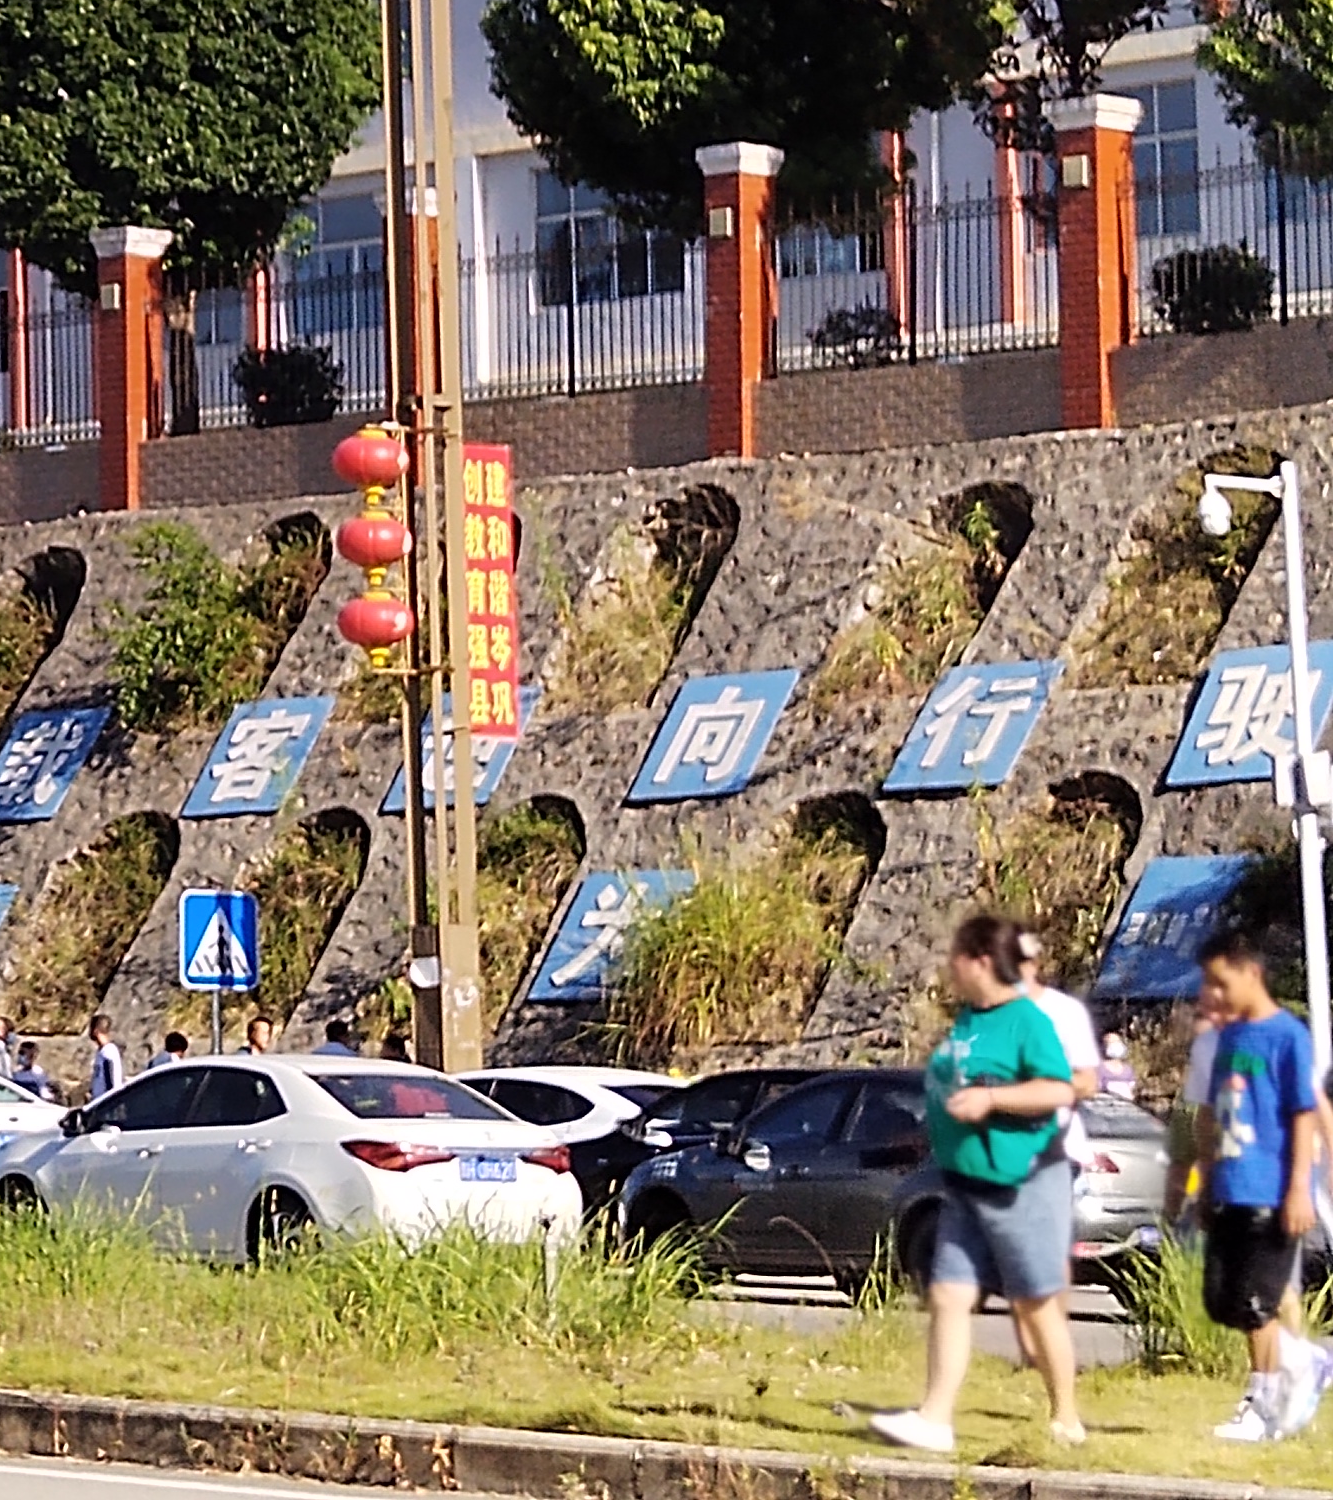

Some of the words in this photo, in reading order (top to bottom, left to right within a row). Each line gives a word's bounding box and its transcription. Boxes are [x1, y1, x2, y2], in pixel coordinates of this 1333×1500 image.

[462, 457, 491, 725] 创教育强县
[485, 460, 515, 725] 建和谐岑巩
[208, 708, 312, 804] 客
[653, 685, 765, 784] 向
[920, 675, 1037, 768] 行
[1195, 663, 1323, 766] 驶
